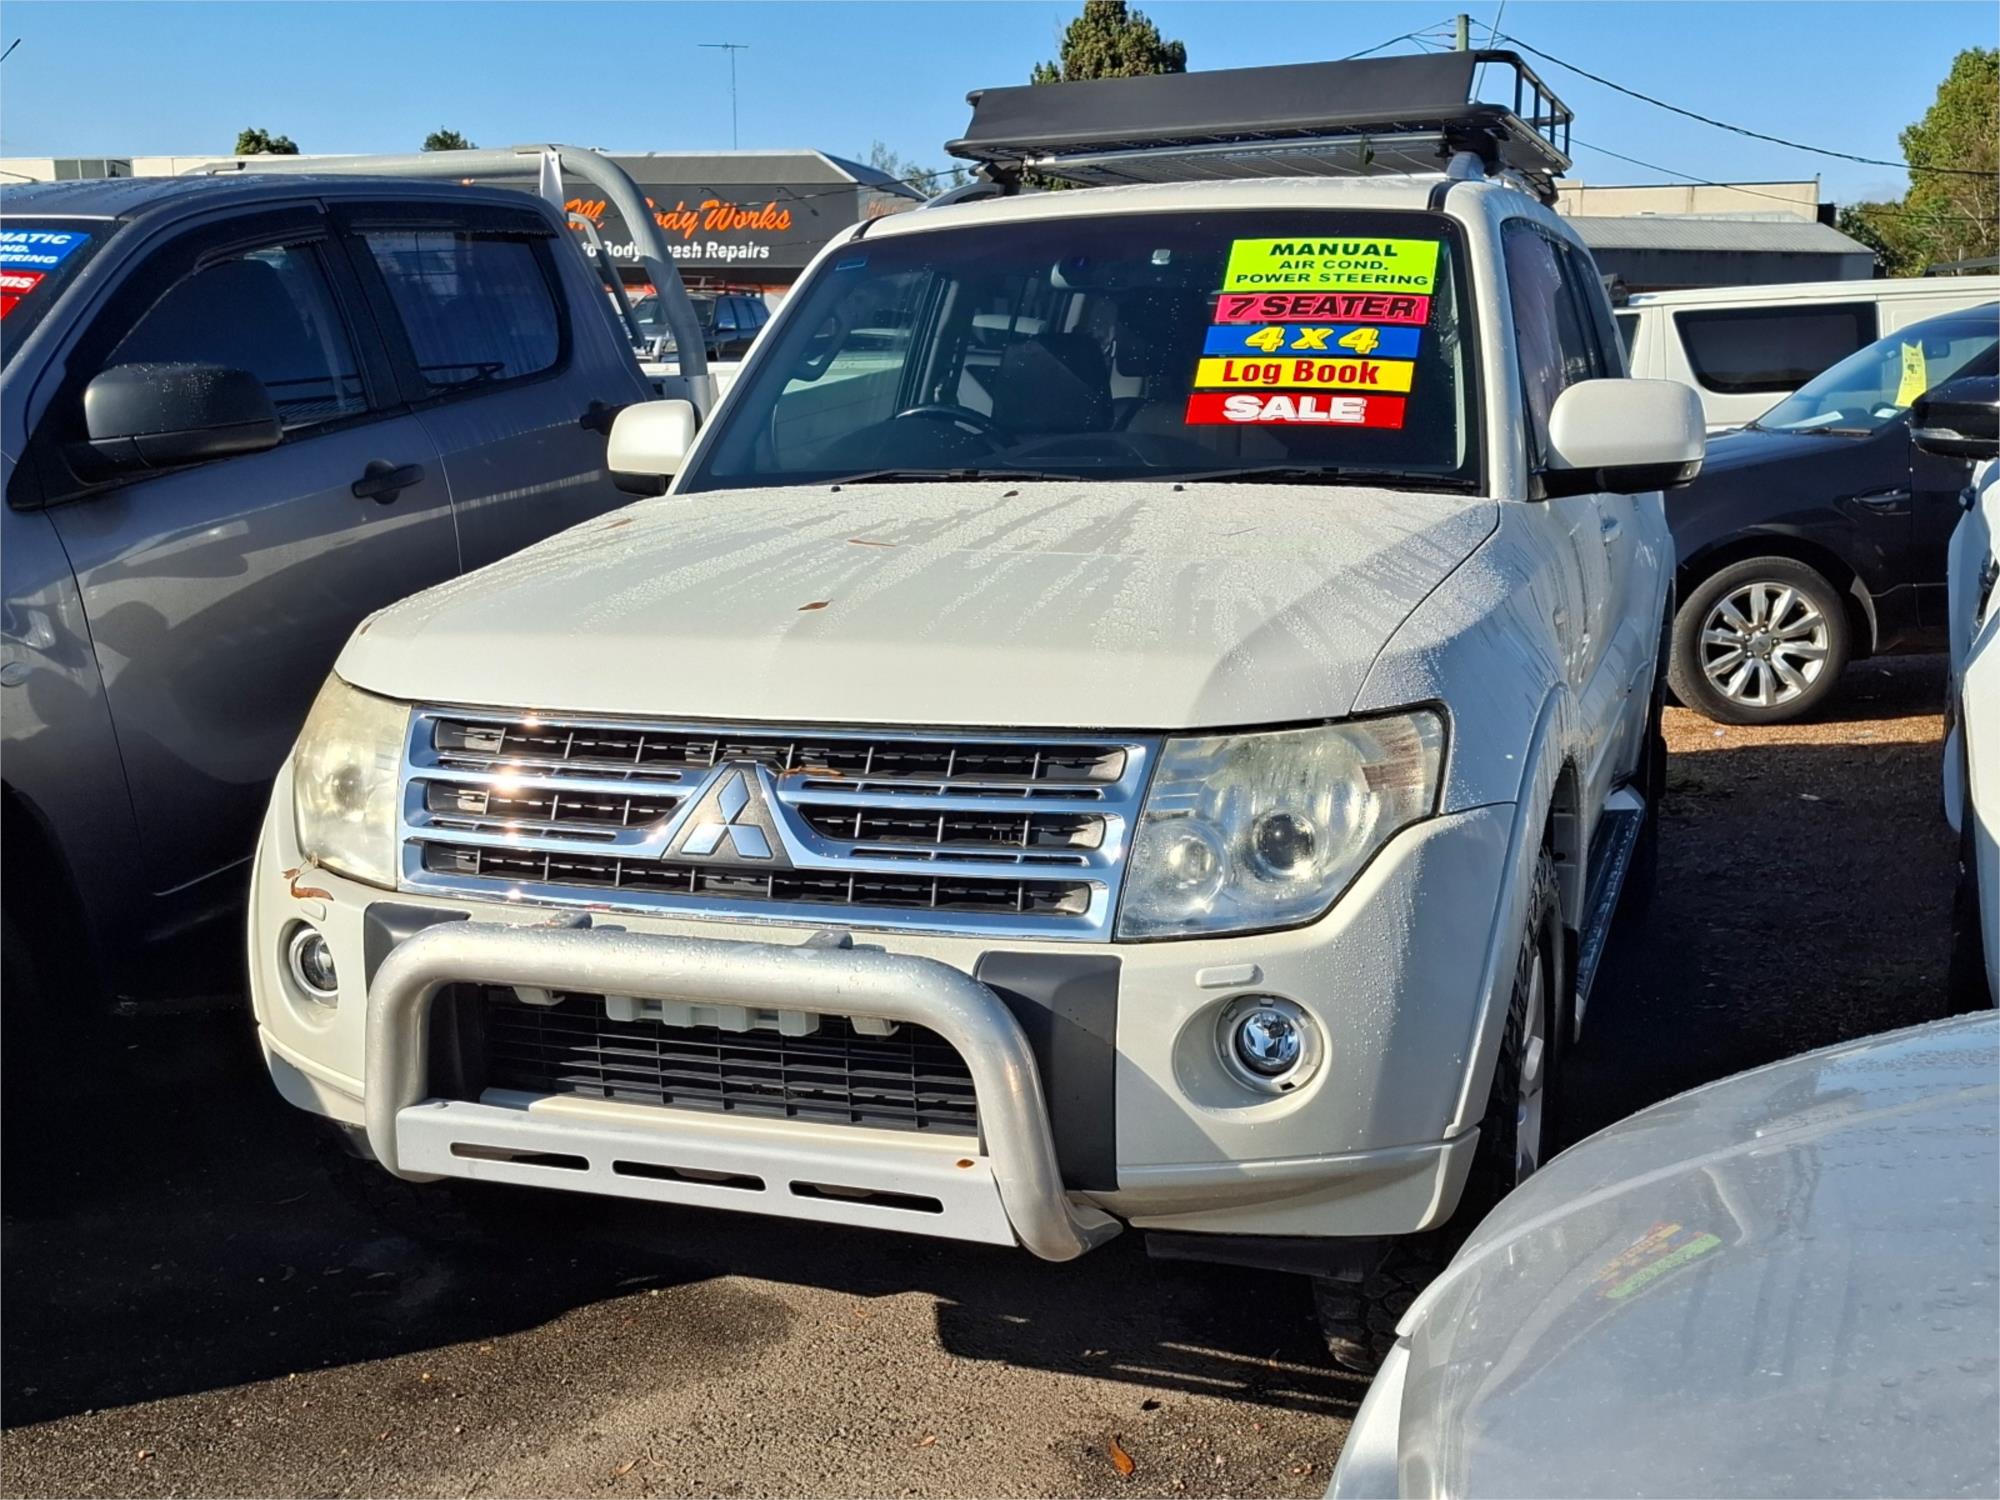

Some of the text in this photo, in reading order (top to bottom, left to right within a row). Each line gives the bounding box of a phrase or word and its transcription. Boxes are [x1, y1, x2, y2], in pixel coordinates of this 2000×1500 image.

[645, 197, 699, 240] ody
[701, 199, 791, 231] Works
[667, 241, 702, 258] ash
[706, 241, 770, 262] Repairs
[1269, 243, 1399, 257] MANUAL
[1279, 260, 1389, 271] AIR COND.
[1235, 272, 1429, 286] POWER STEERING
[1227, 296, 1419, 319] 7 SEATER
[1244, 326, 1286, 353] 4
[1338, 326, 1381, 354] 4
[1222, 359, 1381, 385] Log Book
[1222, 395, 1368, 423] SALE
